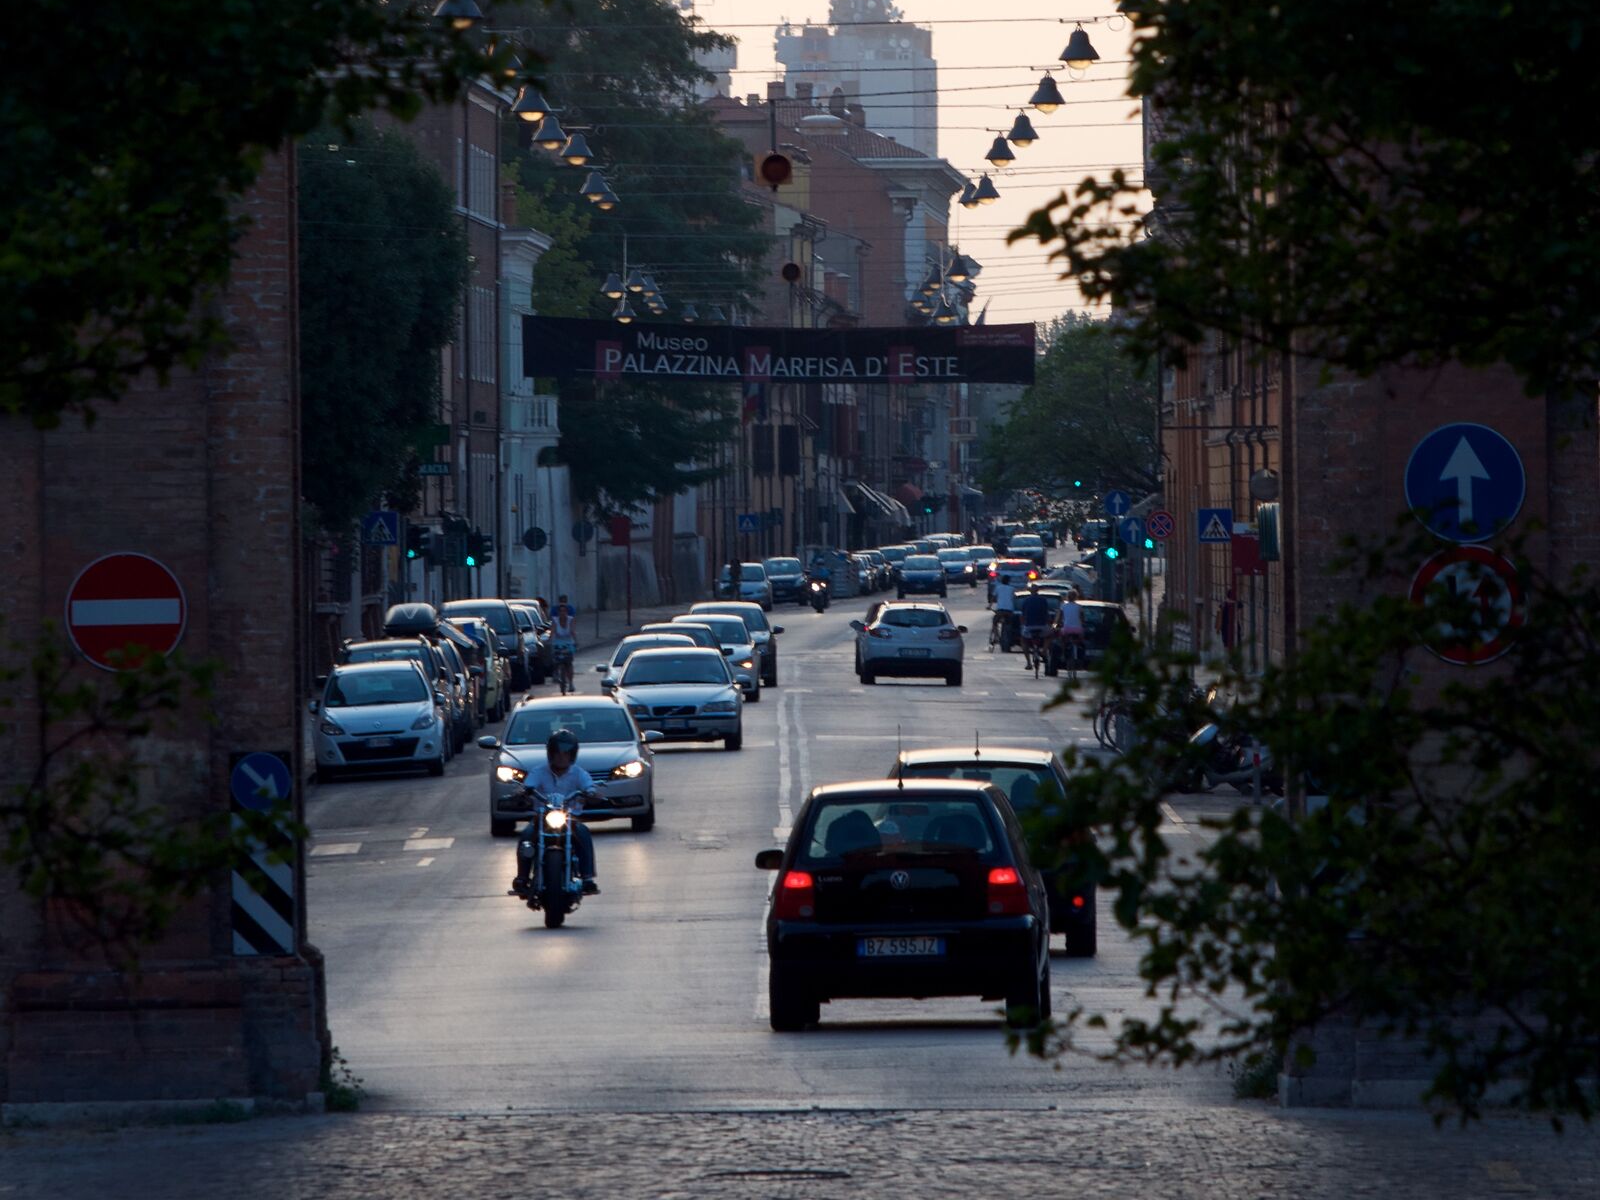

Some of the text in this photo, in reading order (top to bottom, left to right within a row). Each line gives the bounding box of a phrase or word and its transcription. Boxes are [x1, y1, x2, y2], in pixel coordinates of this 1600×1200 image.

[637, 331, 709, 351] Museo
[605, 348, 740, 376] PALAZZINA
[750, 353, 857, 377] MARFISA
[898, 352, 960, 377] ESTE
